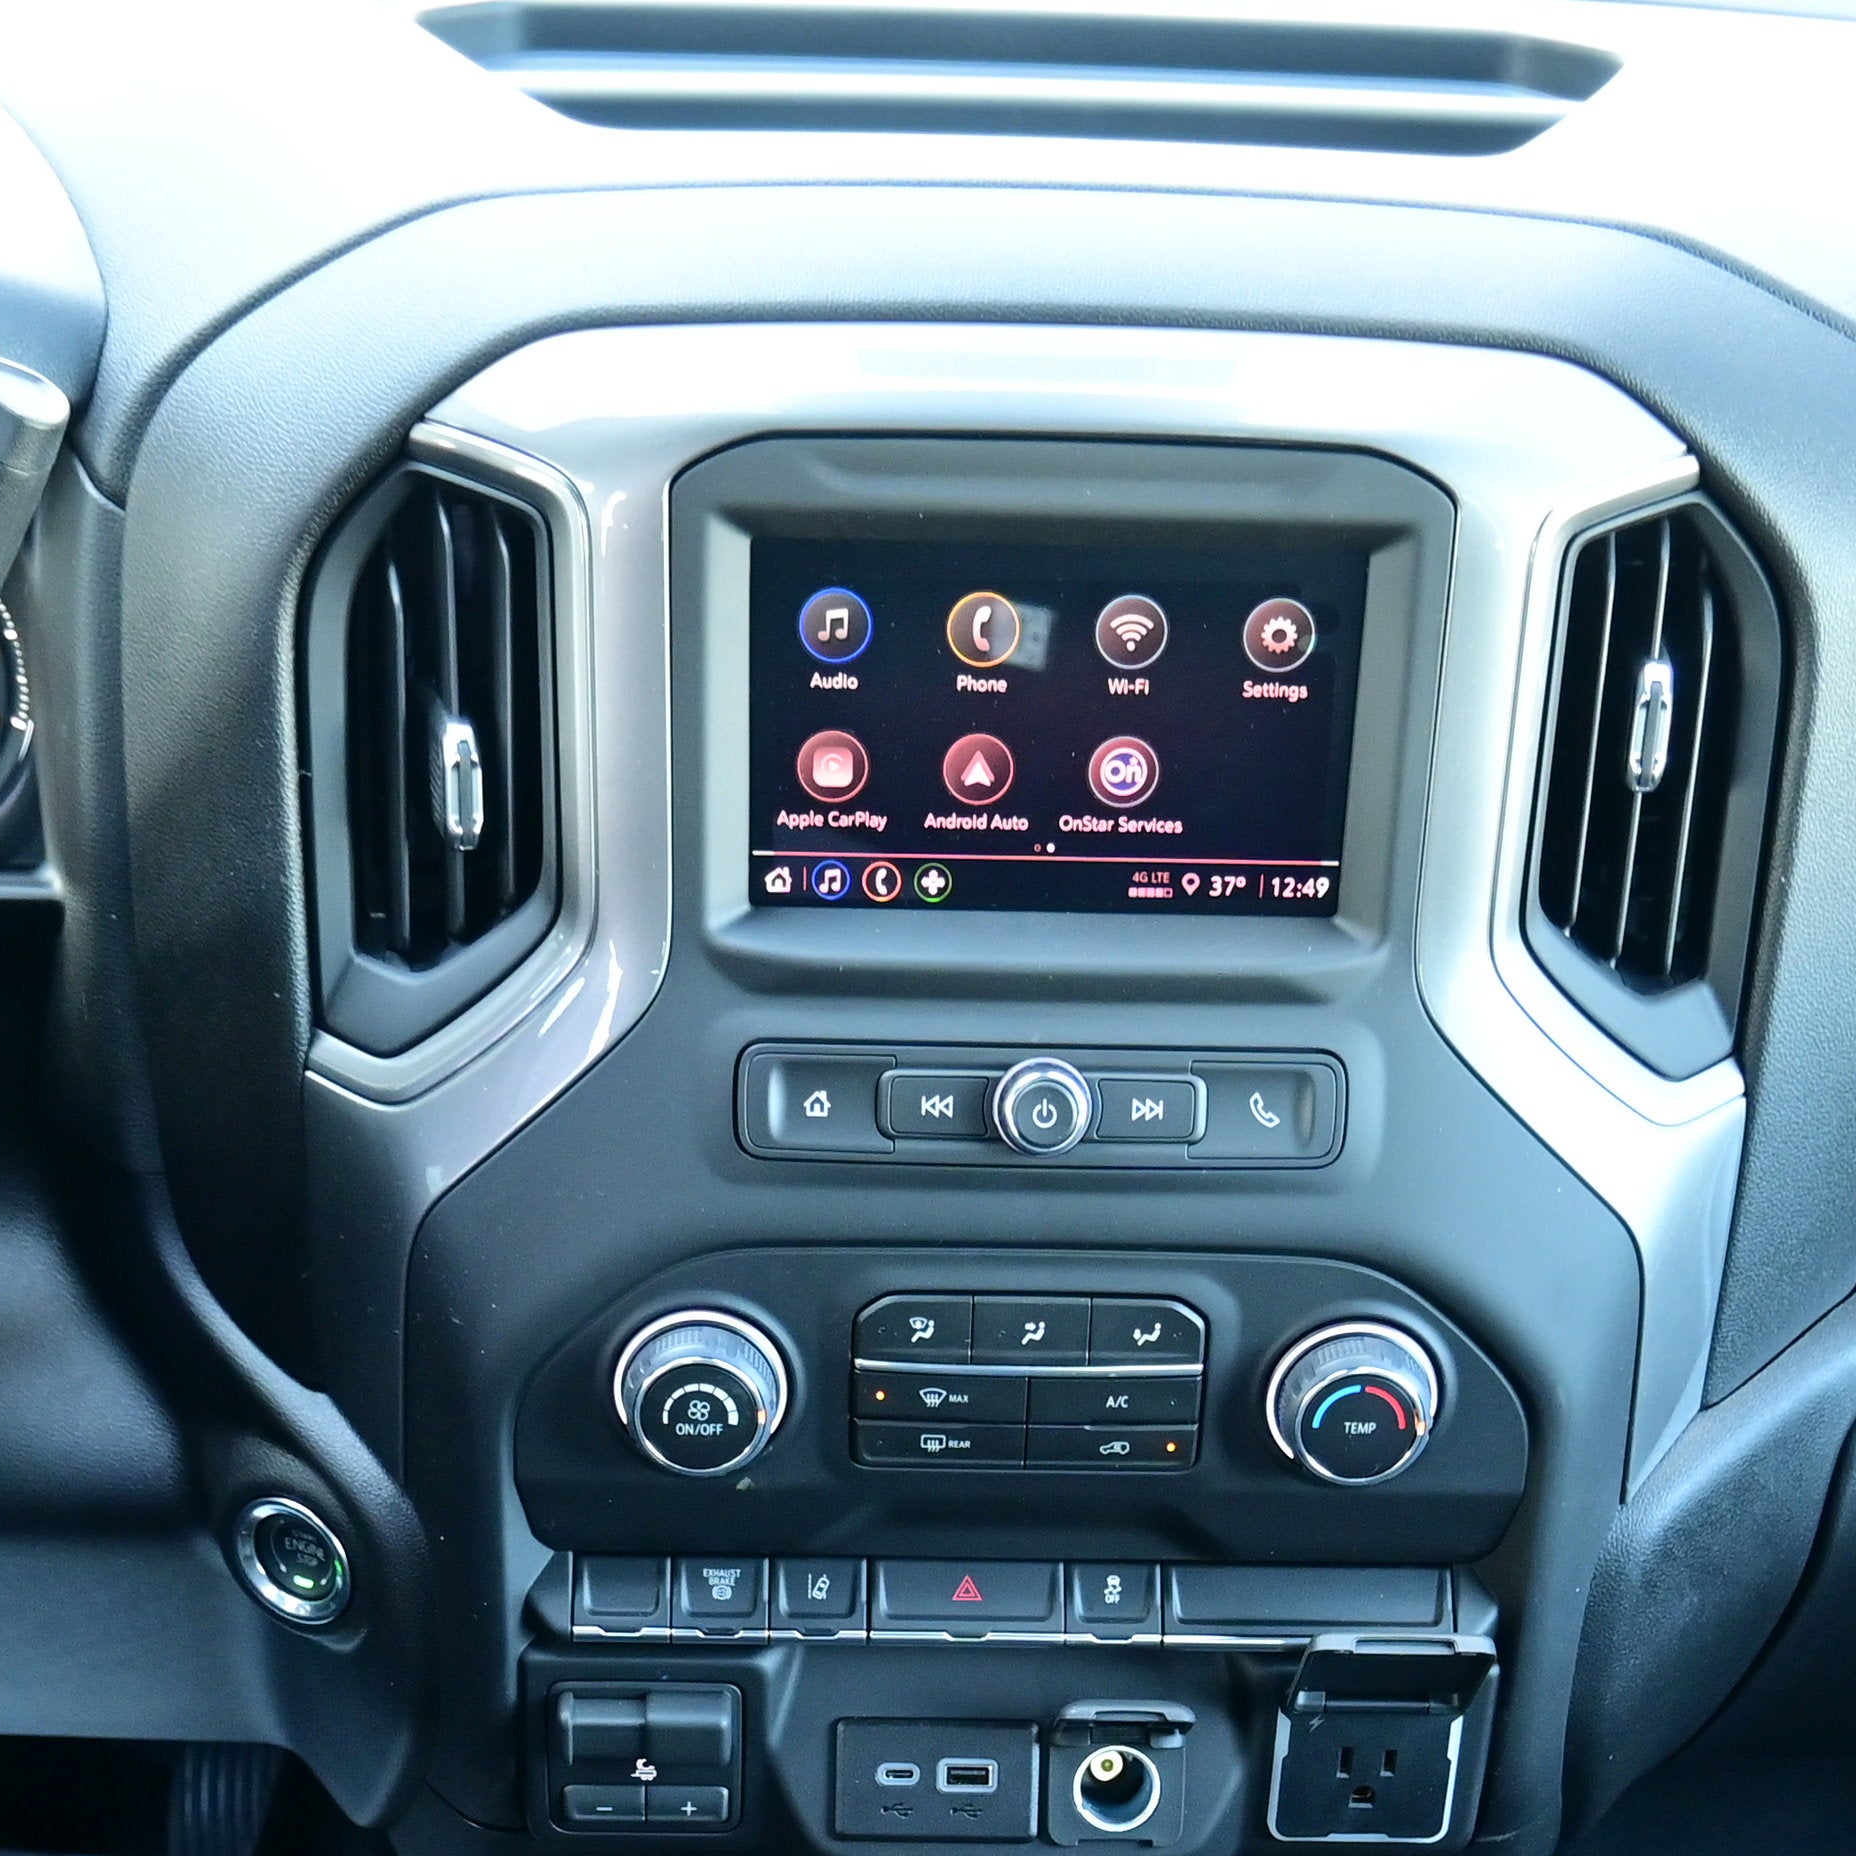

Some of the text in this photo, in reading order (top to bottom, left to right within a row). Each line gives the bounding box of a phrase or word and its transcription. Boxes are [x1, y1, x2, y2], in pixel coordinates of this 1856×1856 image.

[809, 672, 859, 691] Audio
[956, 674, 1008, 695] Phone
[1107, 677, 1150, 696] Wi-Fi
[1241, 680, 1309, 702] Settings
[776, 811, 888, 832] Apple CarPlay
[923, 812, 1029, 832] Android Auto
[1058, 815, 1183, 835] OnStar Services
[1131, 872, 1149, 885] 4G
[1151, 872, 1170, 886] LTE
[1270, 876, 1330, 899] 12:49
[948, 1393, 969, 1404] MAX
[1105, 1395, 1129, 1410] A/C
[675, 1422, 724, 1437] ON/OFF
[1343, 1421, 1377, 1435] TEMP
[948, 1439, 971, 1450] REAR
[702, 1568, 741, 1578] EXHAUST
[708, 1576, 736, 1587] BRAKE
[1104, 1594, 1121, 1604] OFF
